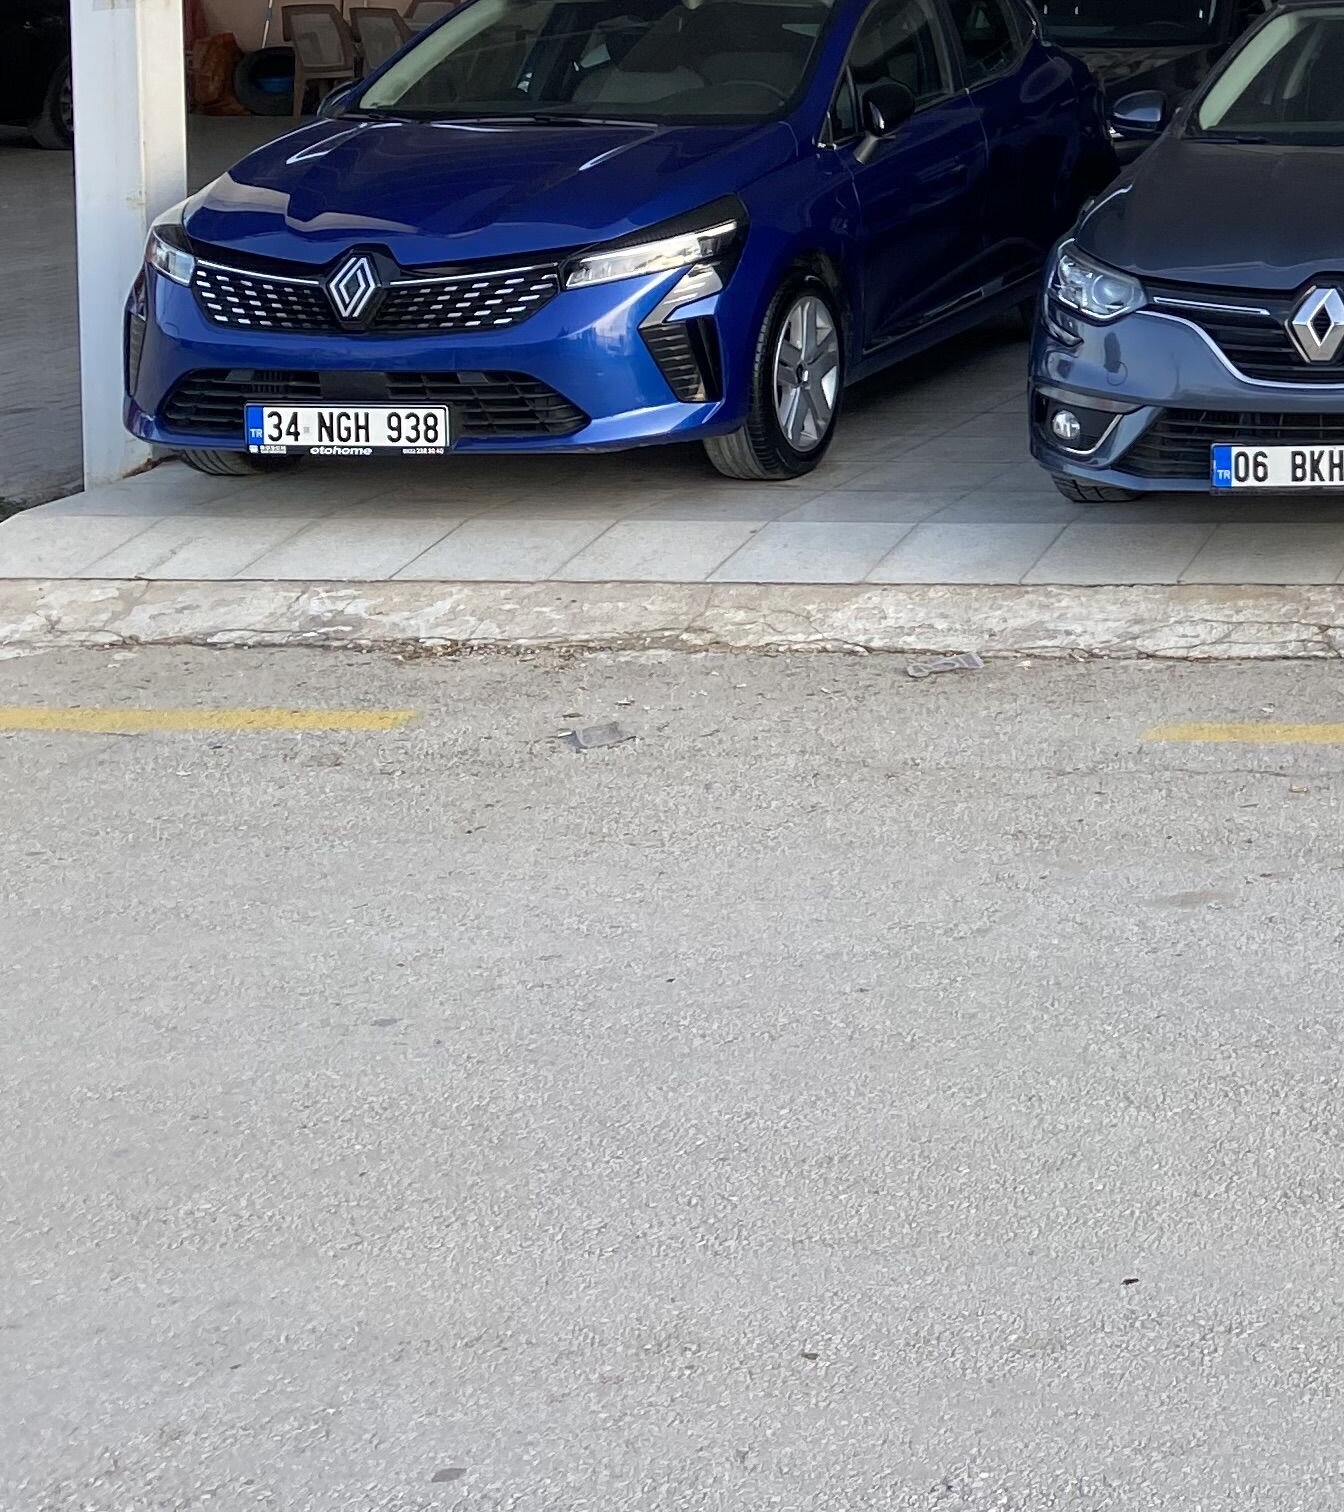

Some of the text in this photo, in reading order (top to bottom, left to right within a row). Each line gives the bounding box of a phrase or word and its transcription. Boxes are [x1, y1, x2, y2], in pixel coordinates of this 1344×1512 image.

[250, 410, 440, 443] TR 34 NGH 938
[309, 445, 373, 456] otohome
[1216, 469, 1231, 480] TR
[1234, 451, 1269, 482] 06
[1291, 449, 1344, 482] BKH
